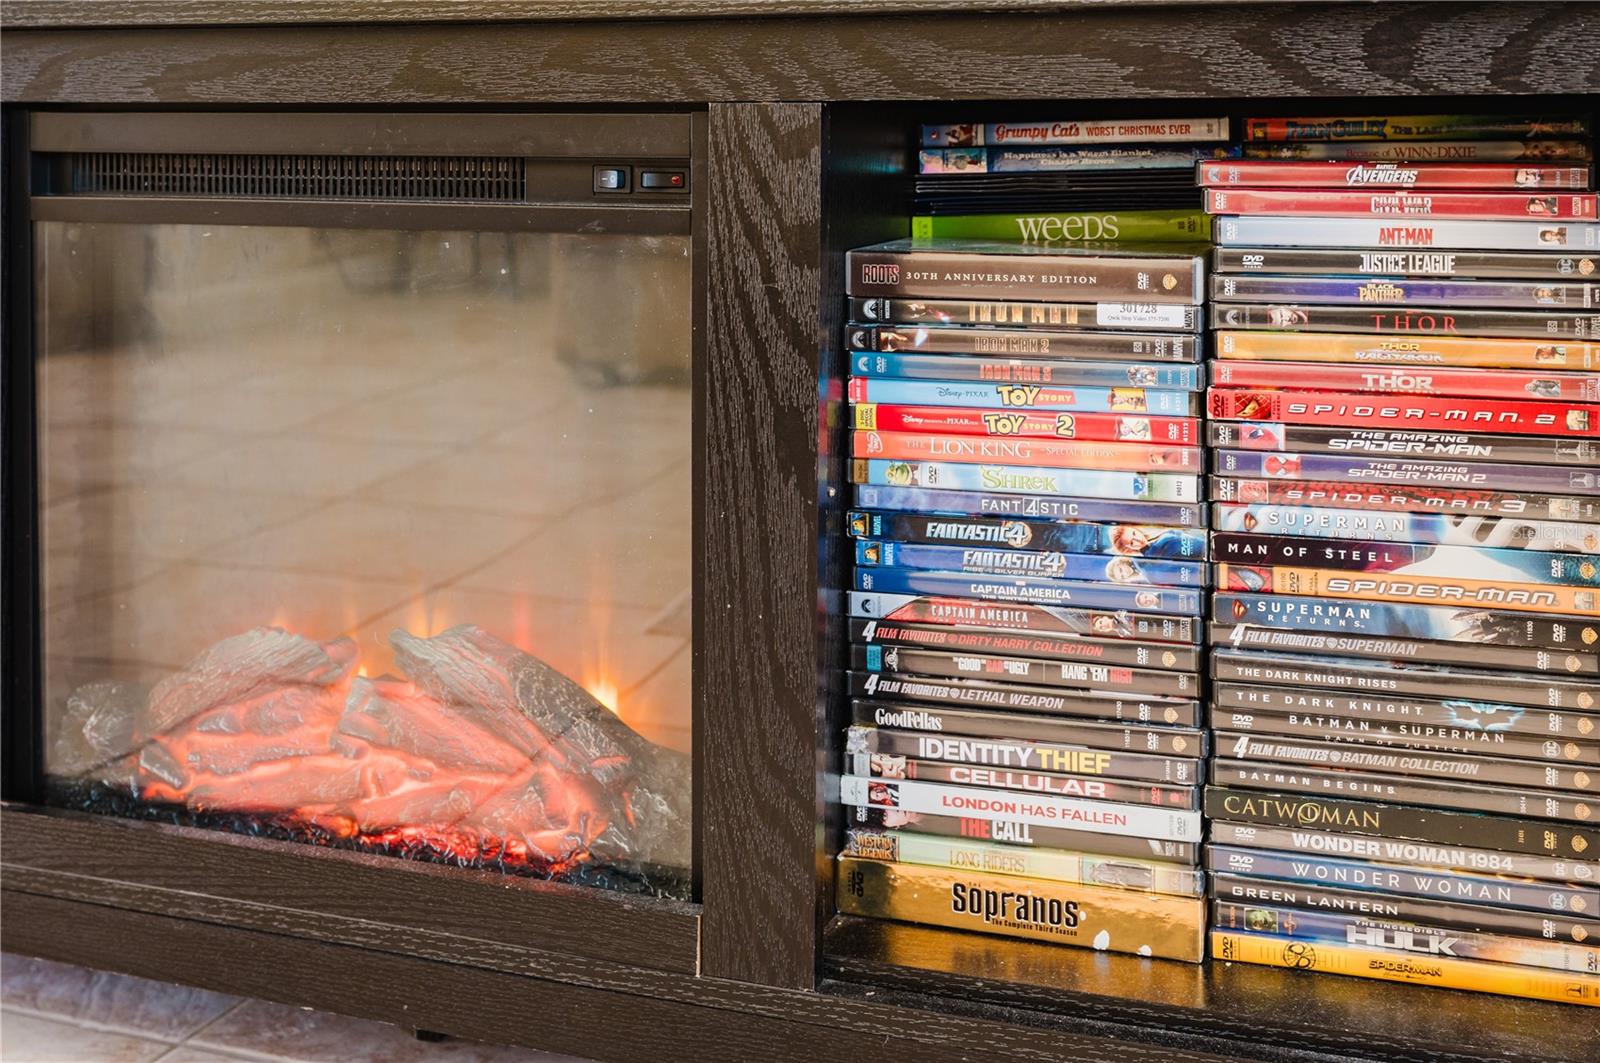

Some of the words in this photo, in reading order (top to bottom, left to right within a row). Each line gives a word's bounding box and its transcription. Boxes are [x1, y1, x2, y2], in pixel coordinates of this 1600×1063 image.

[995, 123, 1048, 142] Grumpy
[1052, 123, 1080, 138] Cat's
[1086, 126, 1116, 137] WORST
[1118, 125, 1167, 136] CHRISTMAS
[1169, 124, 1191, 135] EVER
[1393, 146, 1477, 158] WINN-DIXIE
[1346, 165, 1418, 186] AVENGERS
[1371, 197, 1402, 214] CIVIL
[1402, 197, 1432, 214] WAR
[1379, 228, 1433, 245] ANT-MAN
[863, 264, 899, 284] ROOTS
[1359, 254, 1405, 272] JUSTICE
[1409, 254, 1456, 273] LEAGUE
[906, 271, 938, 280] 30TH
[944, 272, 1035, 282] ANNIVERSARY
[1041, 275, 1097, 284] EDITION
[1359, 288, 1405, 303] PANTHER
[969, 303, 1023, 322] IRON
[1031, 304, 1078, 324] MAN
[1120, 303, 1157, 314] 301728
[1371, 315, 1458, 334] THOR
[975, 337, 1009, 351] IRON
[1010, 337, 1038, 352] MAN
[1040, 339, 1050, 353] 2
[1380, 342, 1420, 351] THOR
[936, 386, 963, 399] Disney
[1361, 374, 1434, 390] THOR
[996, 384, 1041, 406] TOY
[1038, 393, 1072, 402] STORY
[902, 415, 923, 424] Disney
[984, 414, 1027, 435] TOY
[1287, 403, 1520, 423] SPIDER-MAN
[1534, 414, 1557, 425] 2
[1024, 422, 1055, 432] STORY
[1056, 415, 1075, 437] 2
[907, 440, 926, 448] THE
[930, 436, 975, 455] LION
[980, 438, 1031, 458] KING
[1328, 439, 1492, 457] SPIDER-MAN
[1351, 431, 1385, 440] THE
[1390, 432, 1469, 444] AMAZING
[980, 465, 1058, 492] SHREK
[1347, 469, 1469, 482] SPIDER-MAN
[1471, 473, 1487, 484] 2
[1368, 462, 1397, 470] THE
[1402, 464, 1468, 474] AMAZING
[1286, 490, 1491, 510] SPIDER-MAN
[1498, 500, 1527, 513] 3
[873, 515, 882, 536] MARVEL
[1268, 512, 1404, 533] SUPERMAN
[925, 522, 1009, 542] FANTASTIC
[1005, 523, 1026, 545] 4
[1281, 527, 1393, 540] RETURNS
[885, 543, 894, 565] MARVEL
[963, 551, 1044, 570] FANTASTIC
[1043, 552, 1061, 571] 4
[1228, 543, 1268, 555] MAN
[1283, 546, 1308, 557] OF
[1325, 548, 1393, 563] STEEL
[971, 584, 1017, 596] CAPTAIN
[1019, 587, 1071, 599] AMERICA
[1327, 579, 1555, 605] SPIDER-MAN
[931, 605, 975, 619] CAPTAIN
[979, 609, 1029, 623] AMERICA
[1257, 602, 1371, 619] SUPERMAN
[1267, 615, 1362, 628] RETURNS
[862, 621, 877, 642] 4
[876, 627, 899, 639] FILM
[899, 628, 947, 643] FAVORITES
[957, 635, 991, 647] DIRTY
[992, 637, 1031, 650] HARRY
[1032, 637, 1104, 657] COLLECTION
[1229, 623, 1246, 646] 4
[1245, 630, 1270, 643] FILM
[1270, 632, 1326, 648] FAVORITES
[1337, 637, 1418, 656] SUPERMAN
[957, 657, 981, 671] GOOD
[1008, 662, 1030, 675] UGLY
[1061, 664, 1088, 680] HANG
[1089, 667, 1107, 682] 'EM
[1237, 667, 1261, 677] THE
[1265, 669, 1300, 680] DARK
[1305, 673, 1353, 685] KNIGHT
[1358, 678, 1397, 689] RISES
[864, 674, 879, 695] 4
[878, 680, 901, 693] FILM
[901, 682, 950, 698] FAVORITES
[959, 688, 1007, 704] LETHAL
[1009, 693, 1065, 709] WEAPON
[1236, 692, 1271, 702] THE
[1285, 696, 1334, 708] DARK
[1350, 701, 1422, 716] KNIGHT
[874, 708, 943, 731] GoodFellas
[1289, 715, 1369, 731] BATMAN
[1399, 725, 1505, 743] SUPERMAN
[1325, 734, 1365, 743] DAWN
[1405, 743, 1468, 753] JUSTICE
[918, 737, 1033, 767] IDENTITY
[1036, 749, 1111, 774] THIEF
[1233, 736, 1249, 759] 4
[1249, 743, 1273, 755] FILM
[1274, 745, 1330, 761] FAVORITES
[1341, 751, 1398, 767] BATMAN
[1400, 757, 1479, 775] COLLECTION
[950, 767, 1106, 797] CELLULAR
[1239, 771, 1311, 785] BATMAN
[1323, 780, 1395, 794] BEGINS
[943, 795, 1016, 813] LONDON
[1020, 805, 1057, 818] HAS
[1062, 808, 1127, 826] FALLEN
[1224, 796, 1380, 828] CATWOMAN
[960, 817, 992, 839] THE
[992, 820, 1033, 843] CALL
[950, 849, 980, 867] LONG
[984, 853, 1025, 873] RIDERS
[1292, 832, 1381, 856] WONDER
[1385, 842, 1466, 866] WOMAN
[1468, 853, 1513, 871] 1984
[1292, 863, 1400, 888] WONDER
[1414, 877, 1511, 901] WOMAN
[952, 882, 1079, 928] Sopranos
[1232, 886, 1296, 902] GREEN
[1307, 896, 1398, 916] LANTERN
[992, 918, 1003, 926] The
[1004, 919, 1033, 930] Complete
[1035, 924, 1054, 933] Third
[1055, 926, 1078, 936] Season
[1347, 925, 1459, 956] HULK
